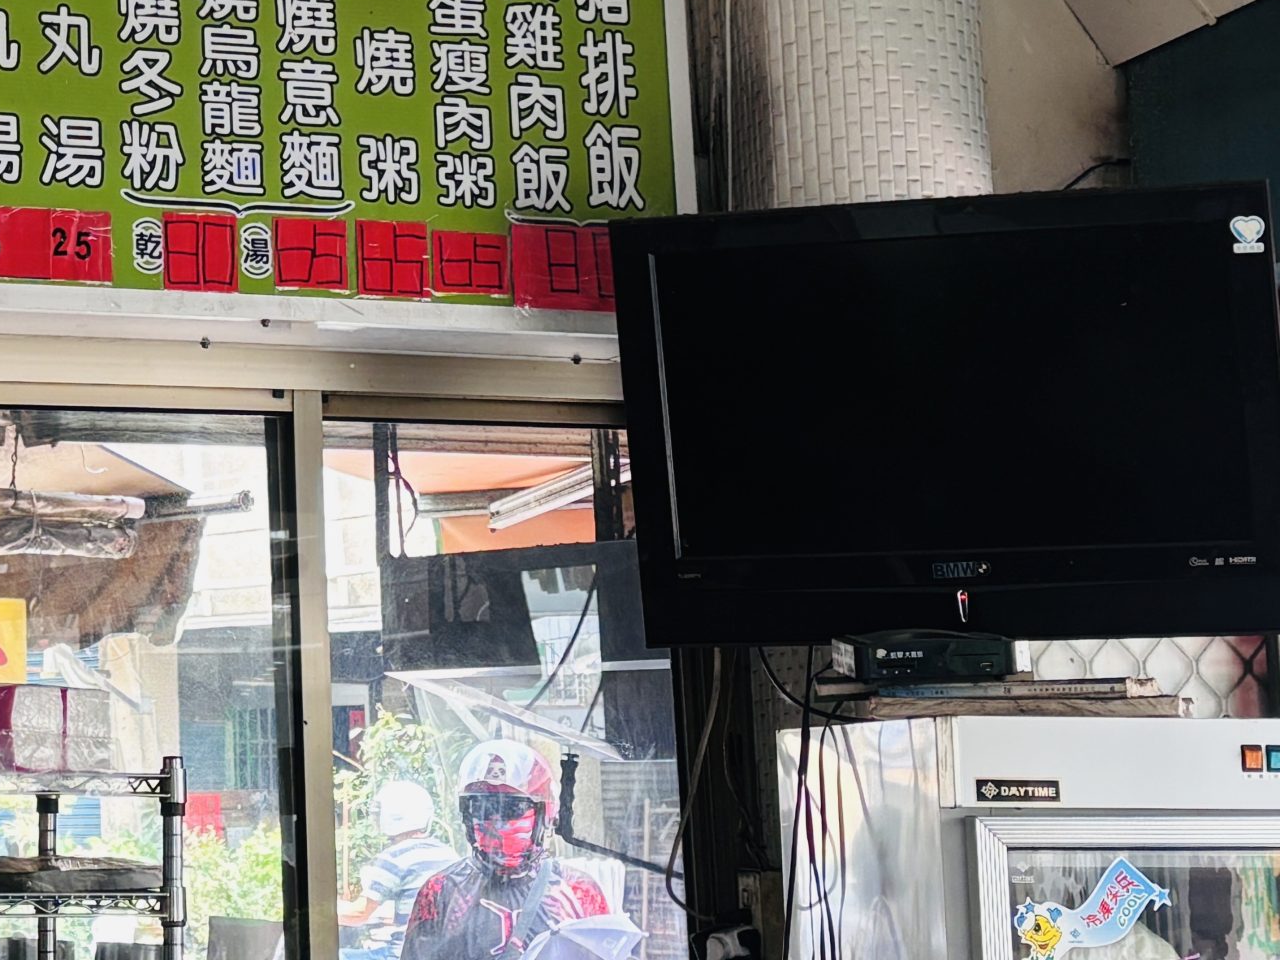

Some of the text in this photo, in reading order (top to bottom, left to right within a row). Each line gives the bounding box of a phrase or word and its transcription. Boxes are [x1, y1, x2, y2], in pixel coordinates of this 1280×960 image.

[51, 227, 92, 260] 25
[164, 220, 234, 285] 80
[274, 220, 345, 284] 65
[360, 223, 427, 295] 65
[438, 235, 503, 289] 65
[933, 562, 976, 578] BMW
[1000, 786, 1057, 797] DAYTIME
[1118, 894, 1146, 927] COOL
